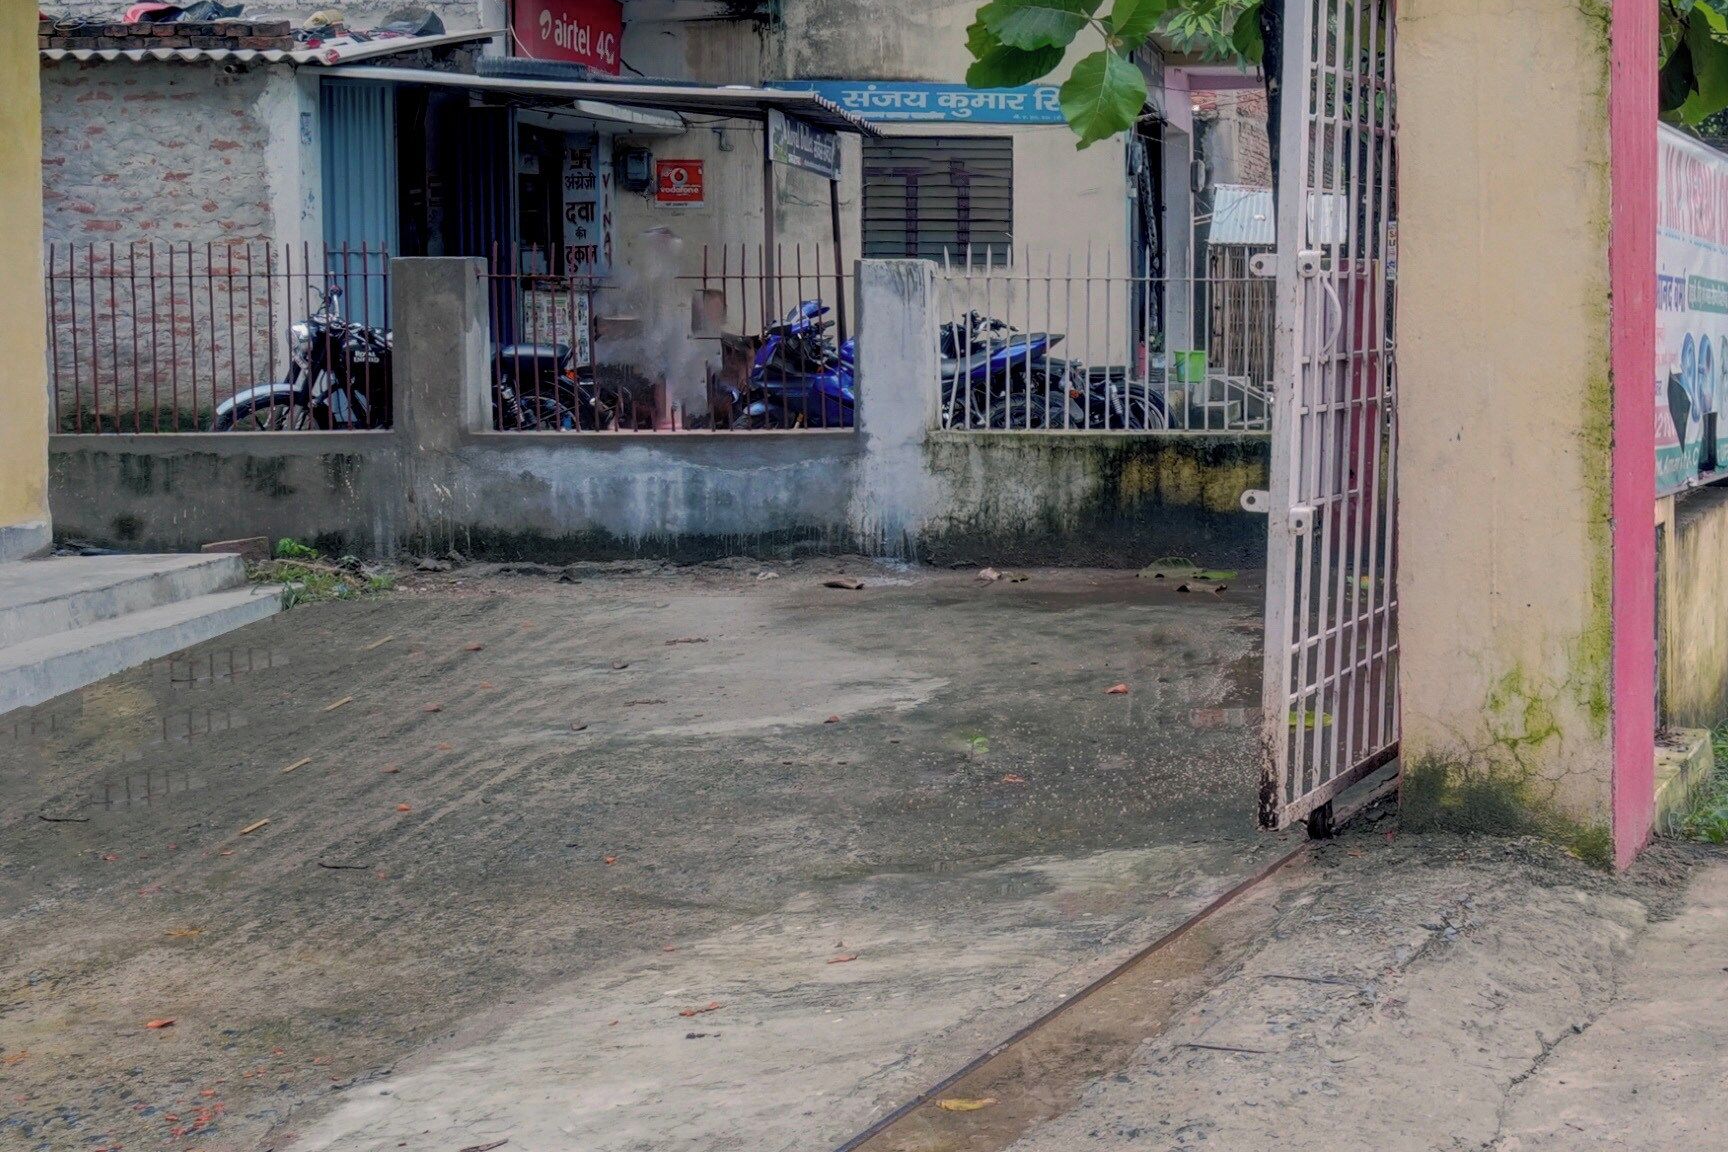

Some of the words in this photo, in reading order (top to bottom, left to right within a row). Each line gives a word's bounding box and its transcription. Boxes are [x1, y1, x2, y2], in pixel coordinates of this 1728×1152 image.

[554, 12, 591, 56] airtel
[596, 30, 615, 65] 4G
[842, 84, 928, 109] संजय
[937, 91, 1028, 118] कुमार
[660, 184, 699, 194] vodafone
[565, 201, 597, 225] दवा
[575, 225, 587, 240] की
